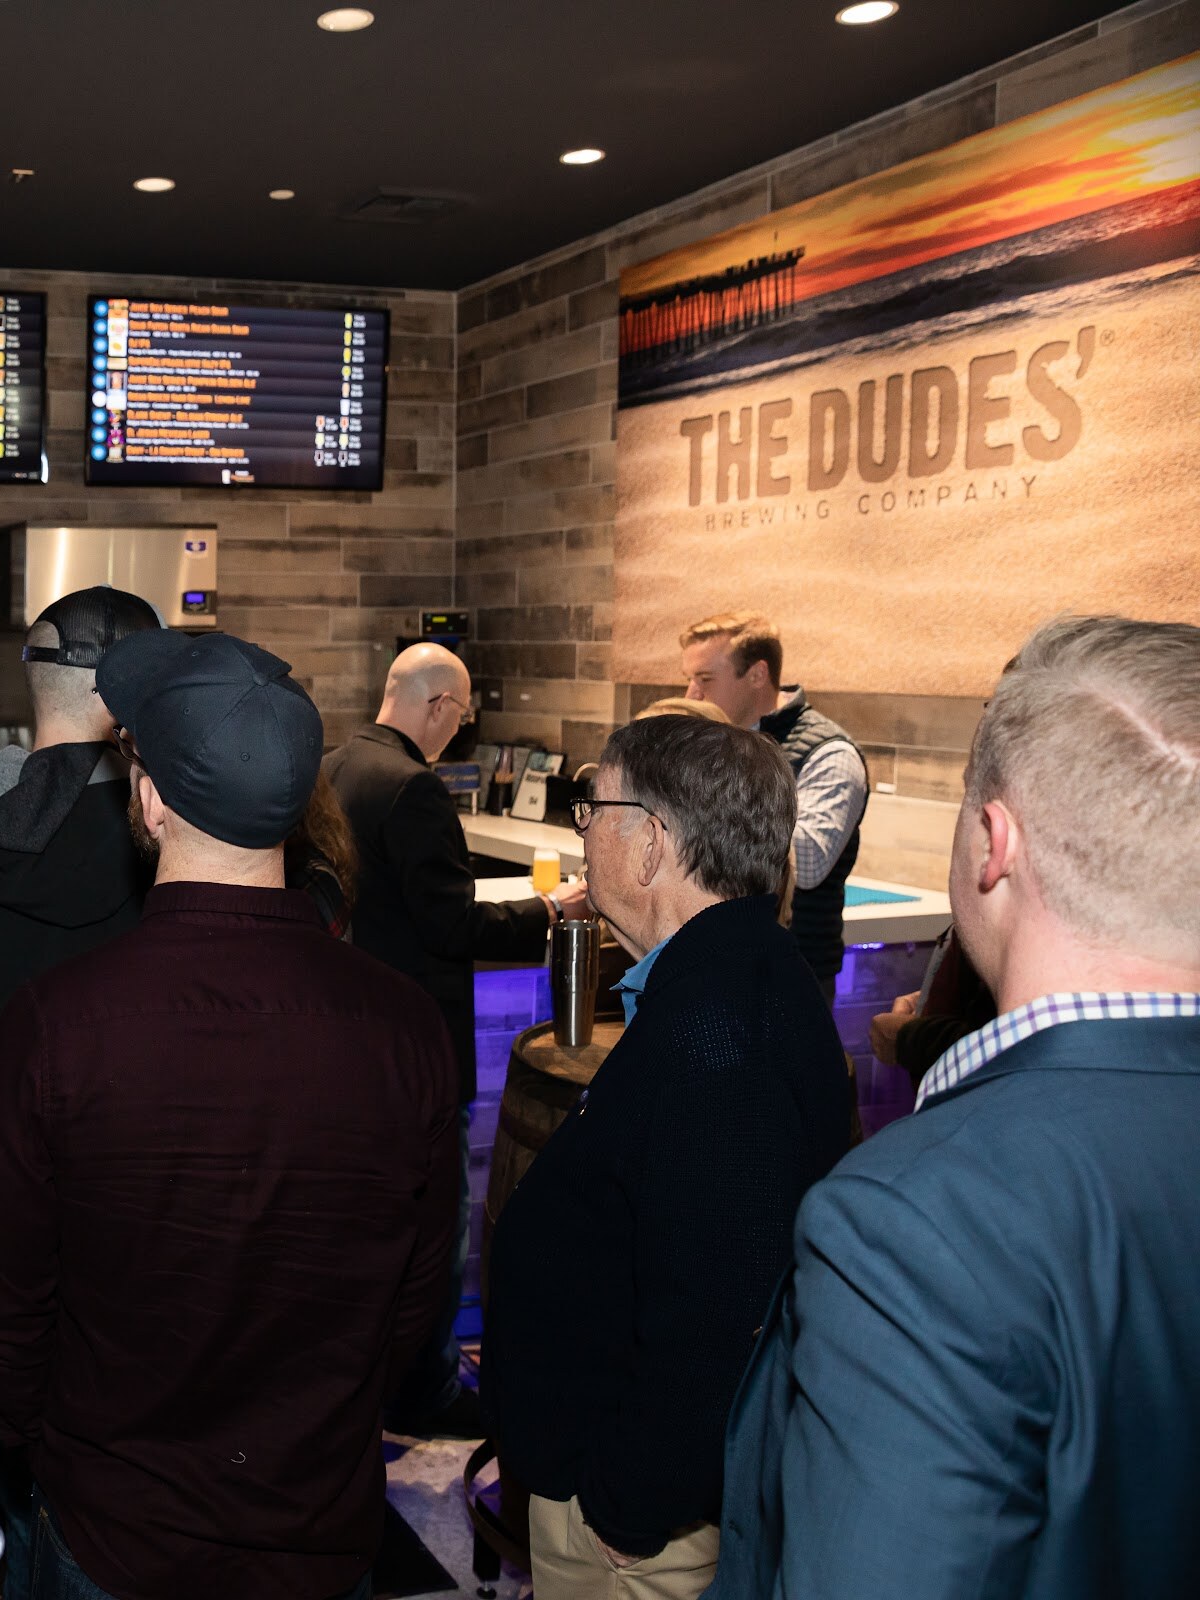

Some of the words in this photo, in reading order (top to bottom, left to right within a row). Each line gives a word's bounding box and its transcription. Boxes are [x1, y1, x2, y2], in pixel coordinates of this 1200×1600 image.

[680, 398, 792, 507] THE
[807, 325, 1095, 491] DUDES'
[705, 499, 829, 532] BREWING
[858, 475, 1037, 516] COMPANY
